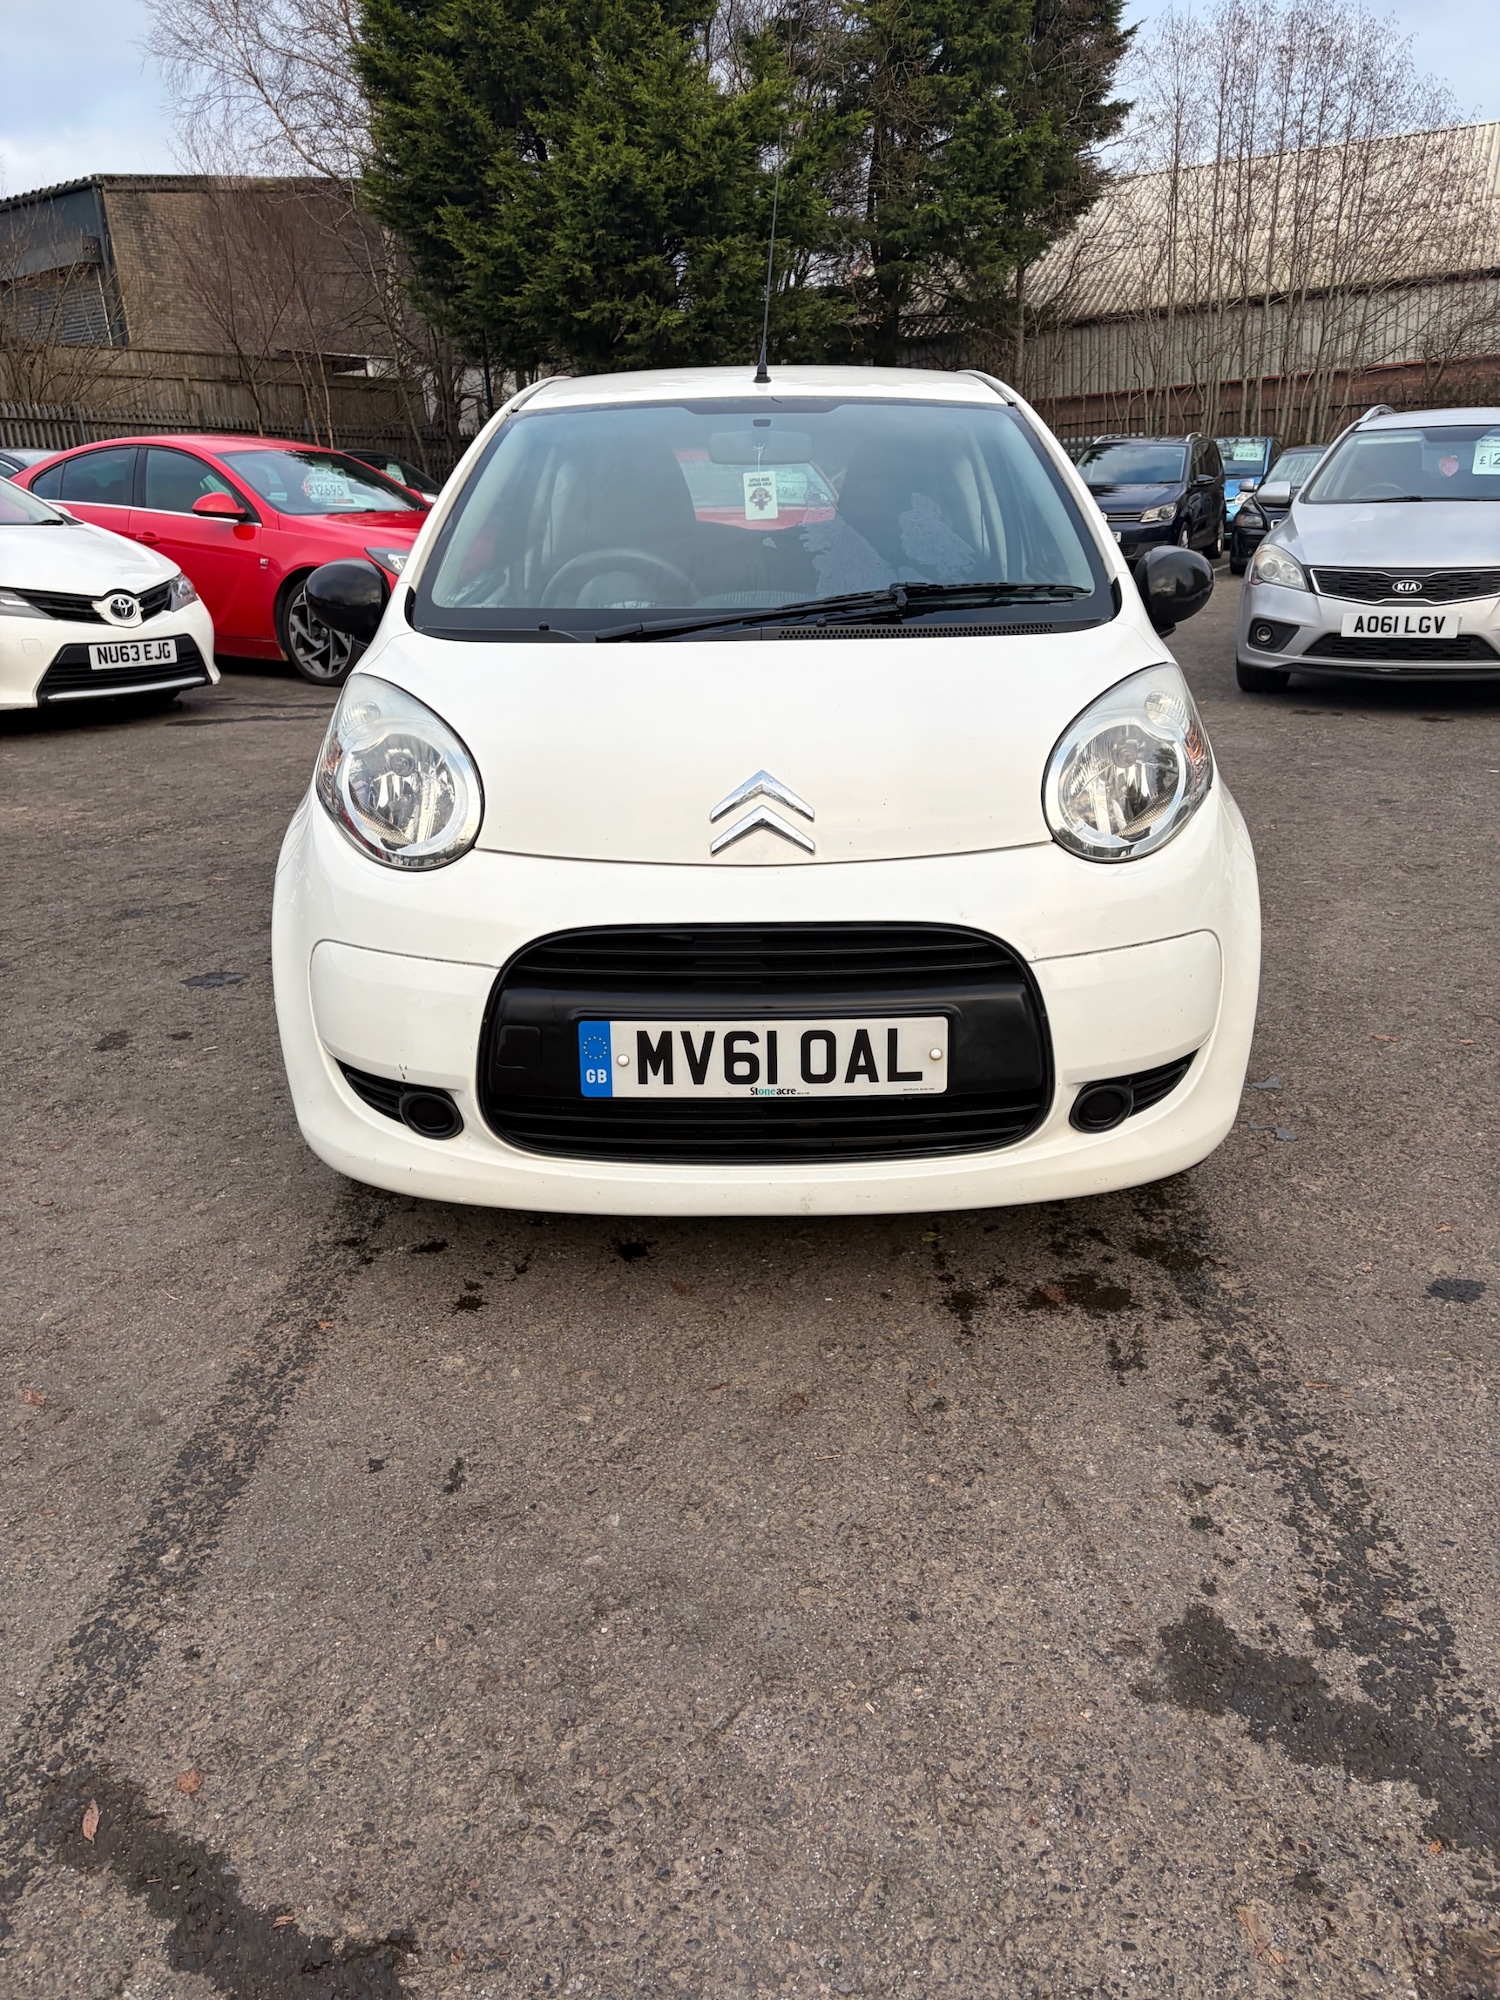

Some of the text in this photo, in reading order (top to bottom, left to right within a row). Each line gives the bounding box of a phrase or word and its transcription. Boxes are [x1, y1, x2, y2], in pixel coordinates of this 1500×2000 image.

[1396, 582, 1418, 591] KIA
[1353, 615, 1446, 634] AO61 LGV
[96, 642, 171, 665] NU63 EJG
[636, 1028, 923, 1085] MV61 OAL
[585, 1069, 608, 1084] GB
[750, 1086, 797, 1096] Stoneacre
